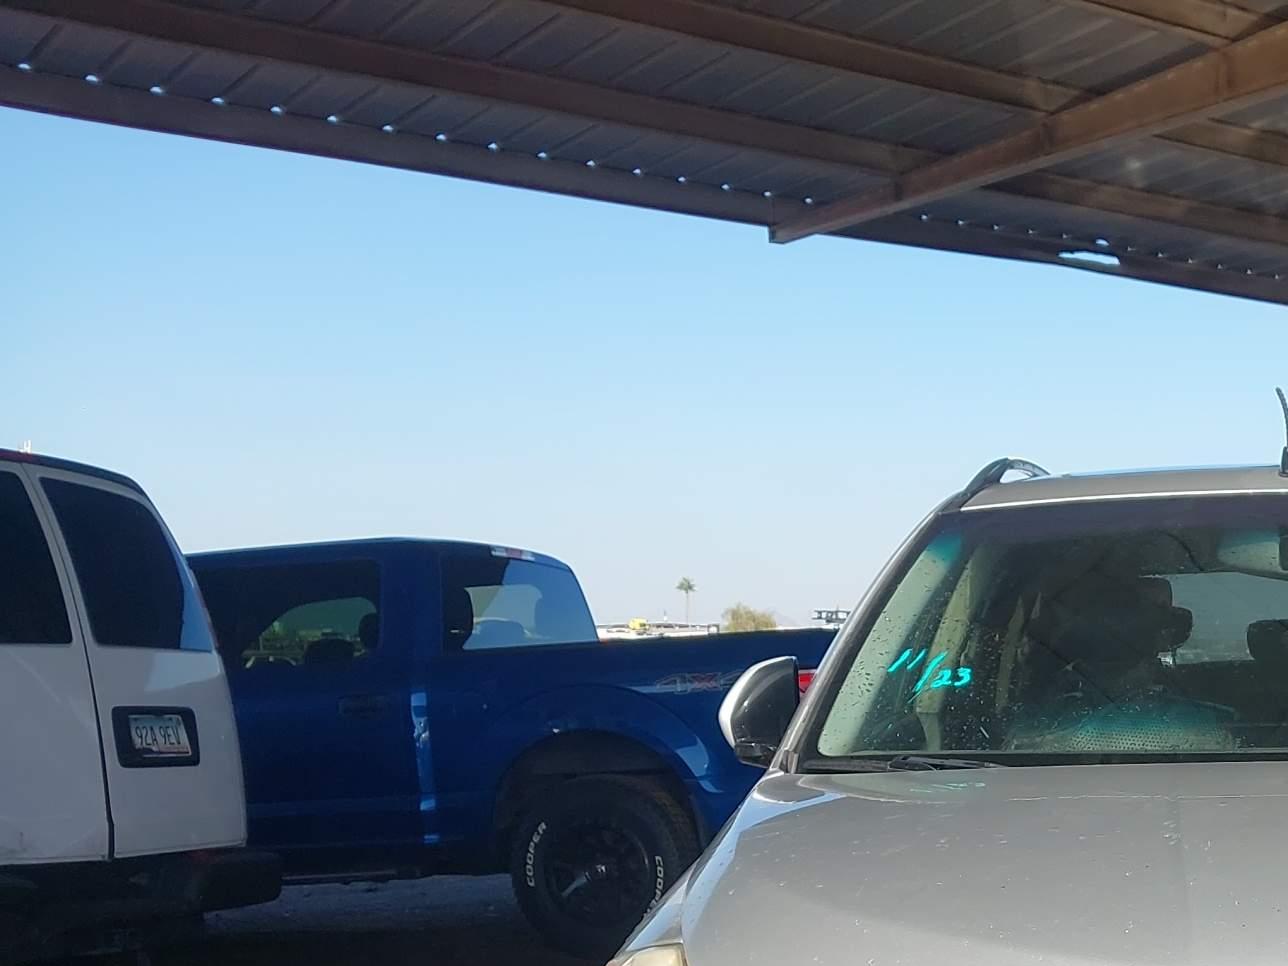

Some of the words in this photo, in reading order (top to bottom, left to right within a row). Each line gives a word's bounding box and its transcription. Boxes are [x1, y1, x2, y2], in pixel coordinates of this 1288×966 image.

[887, 648, 973, 703] 11/23
[525, 822, 547, 887] COOPER
[645, 855, 664, 912] COOP
